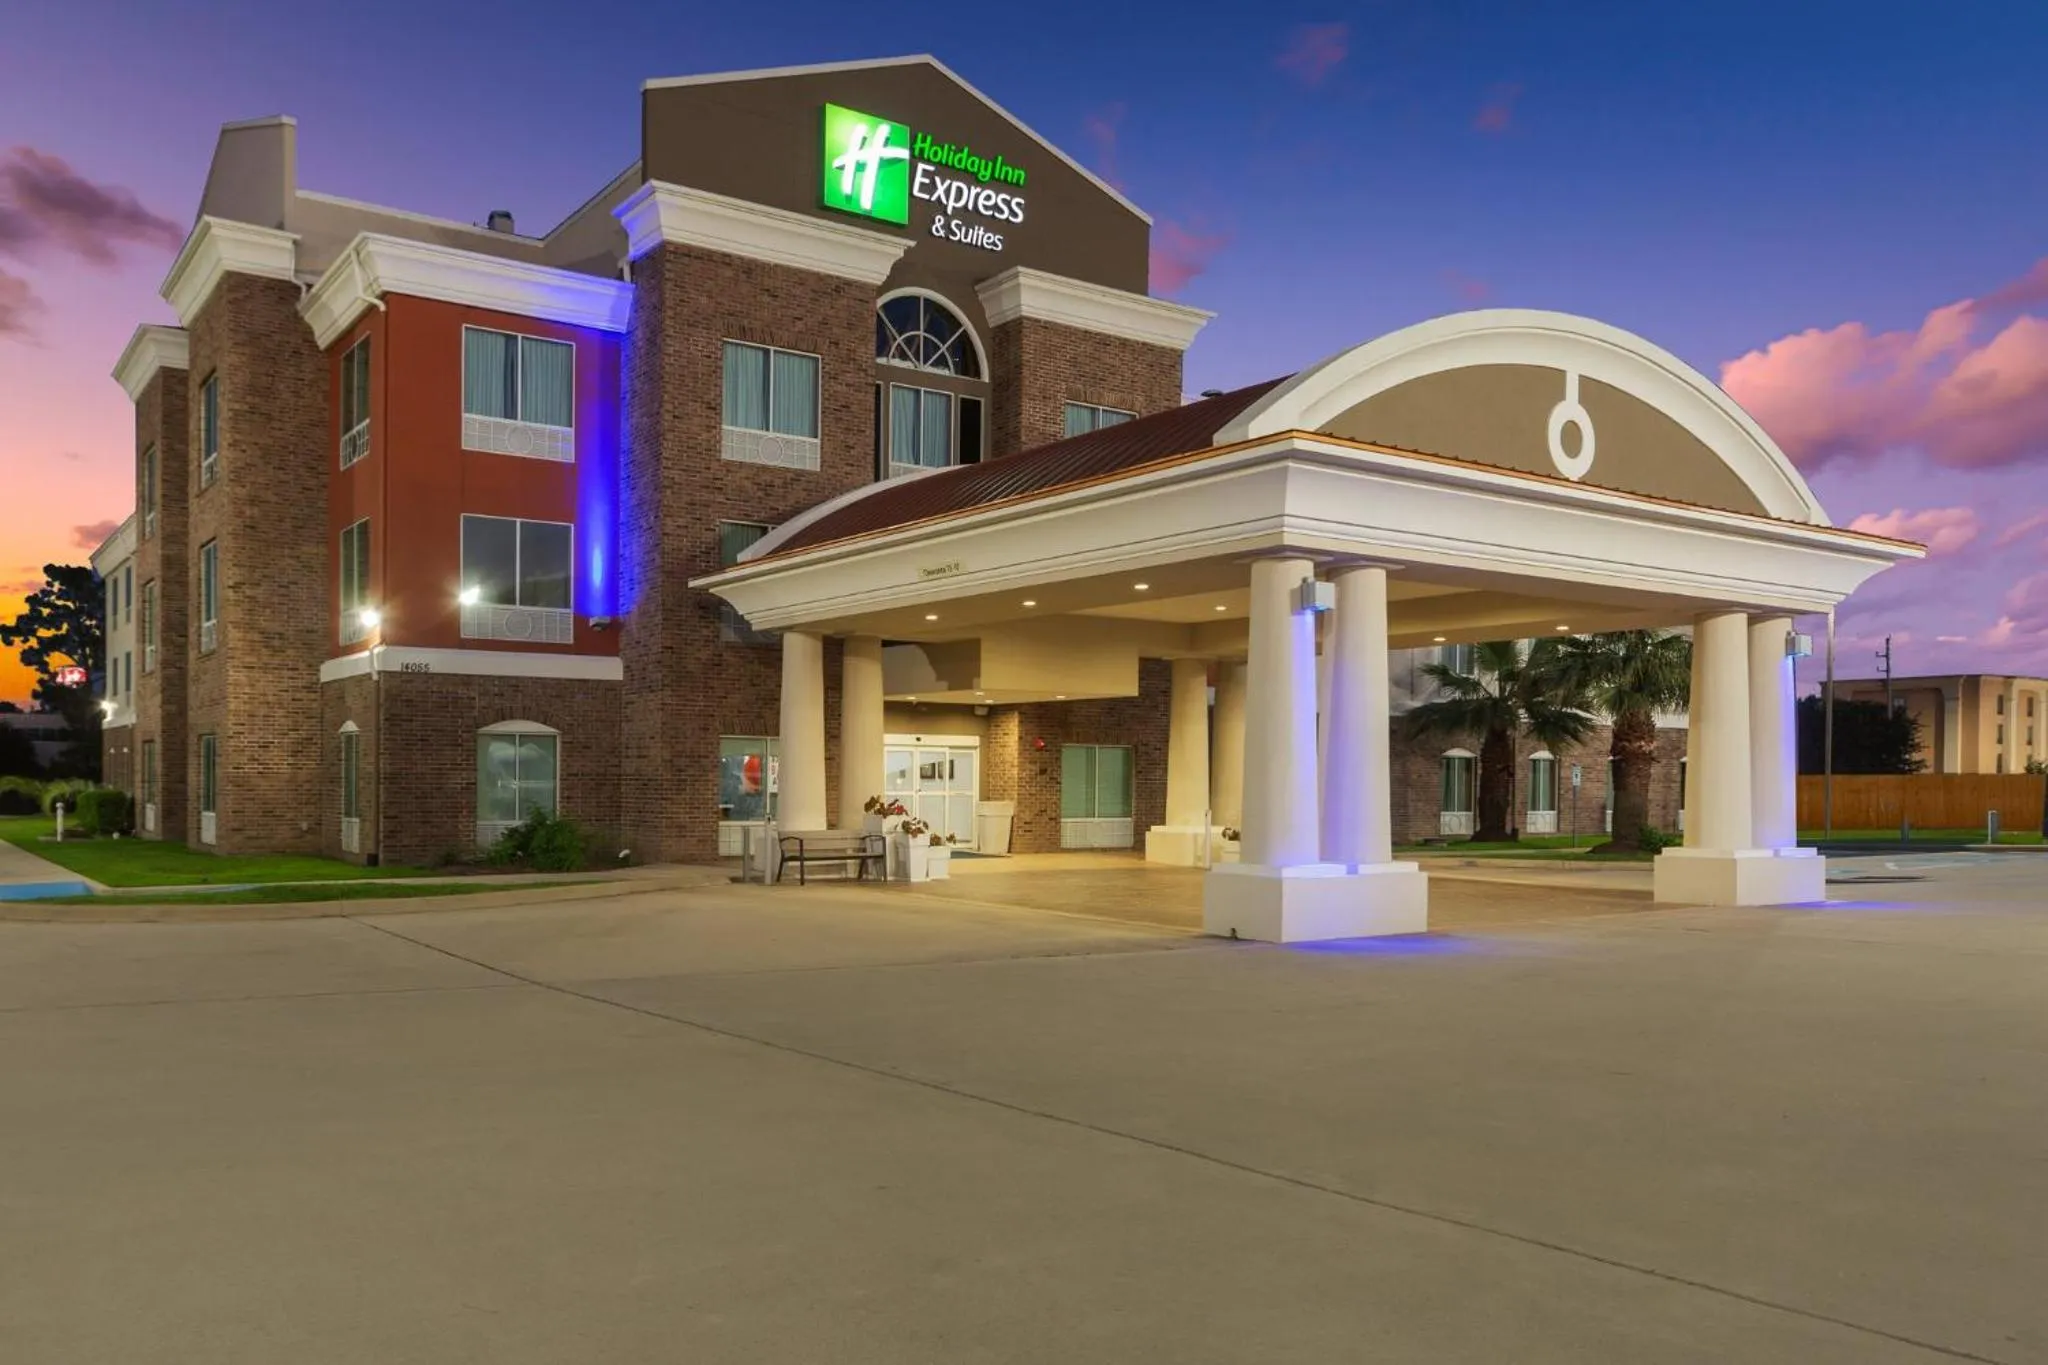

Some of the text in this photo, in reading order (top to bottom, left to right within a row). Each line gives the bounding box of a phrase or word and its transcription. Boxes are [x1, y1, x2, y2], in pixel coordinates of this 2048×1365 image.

[914, 132, 1026, 186] Holiday Inn
[912, 162, 1025, 223] Express
[932, 215, 1004, 251] & Suites
